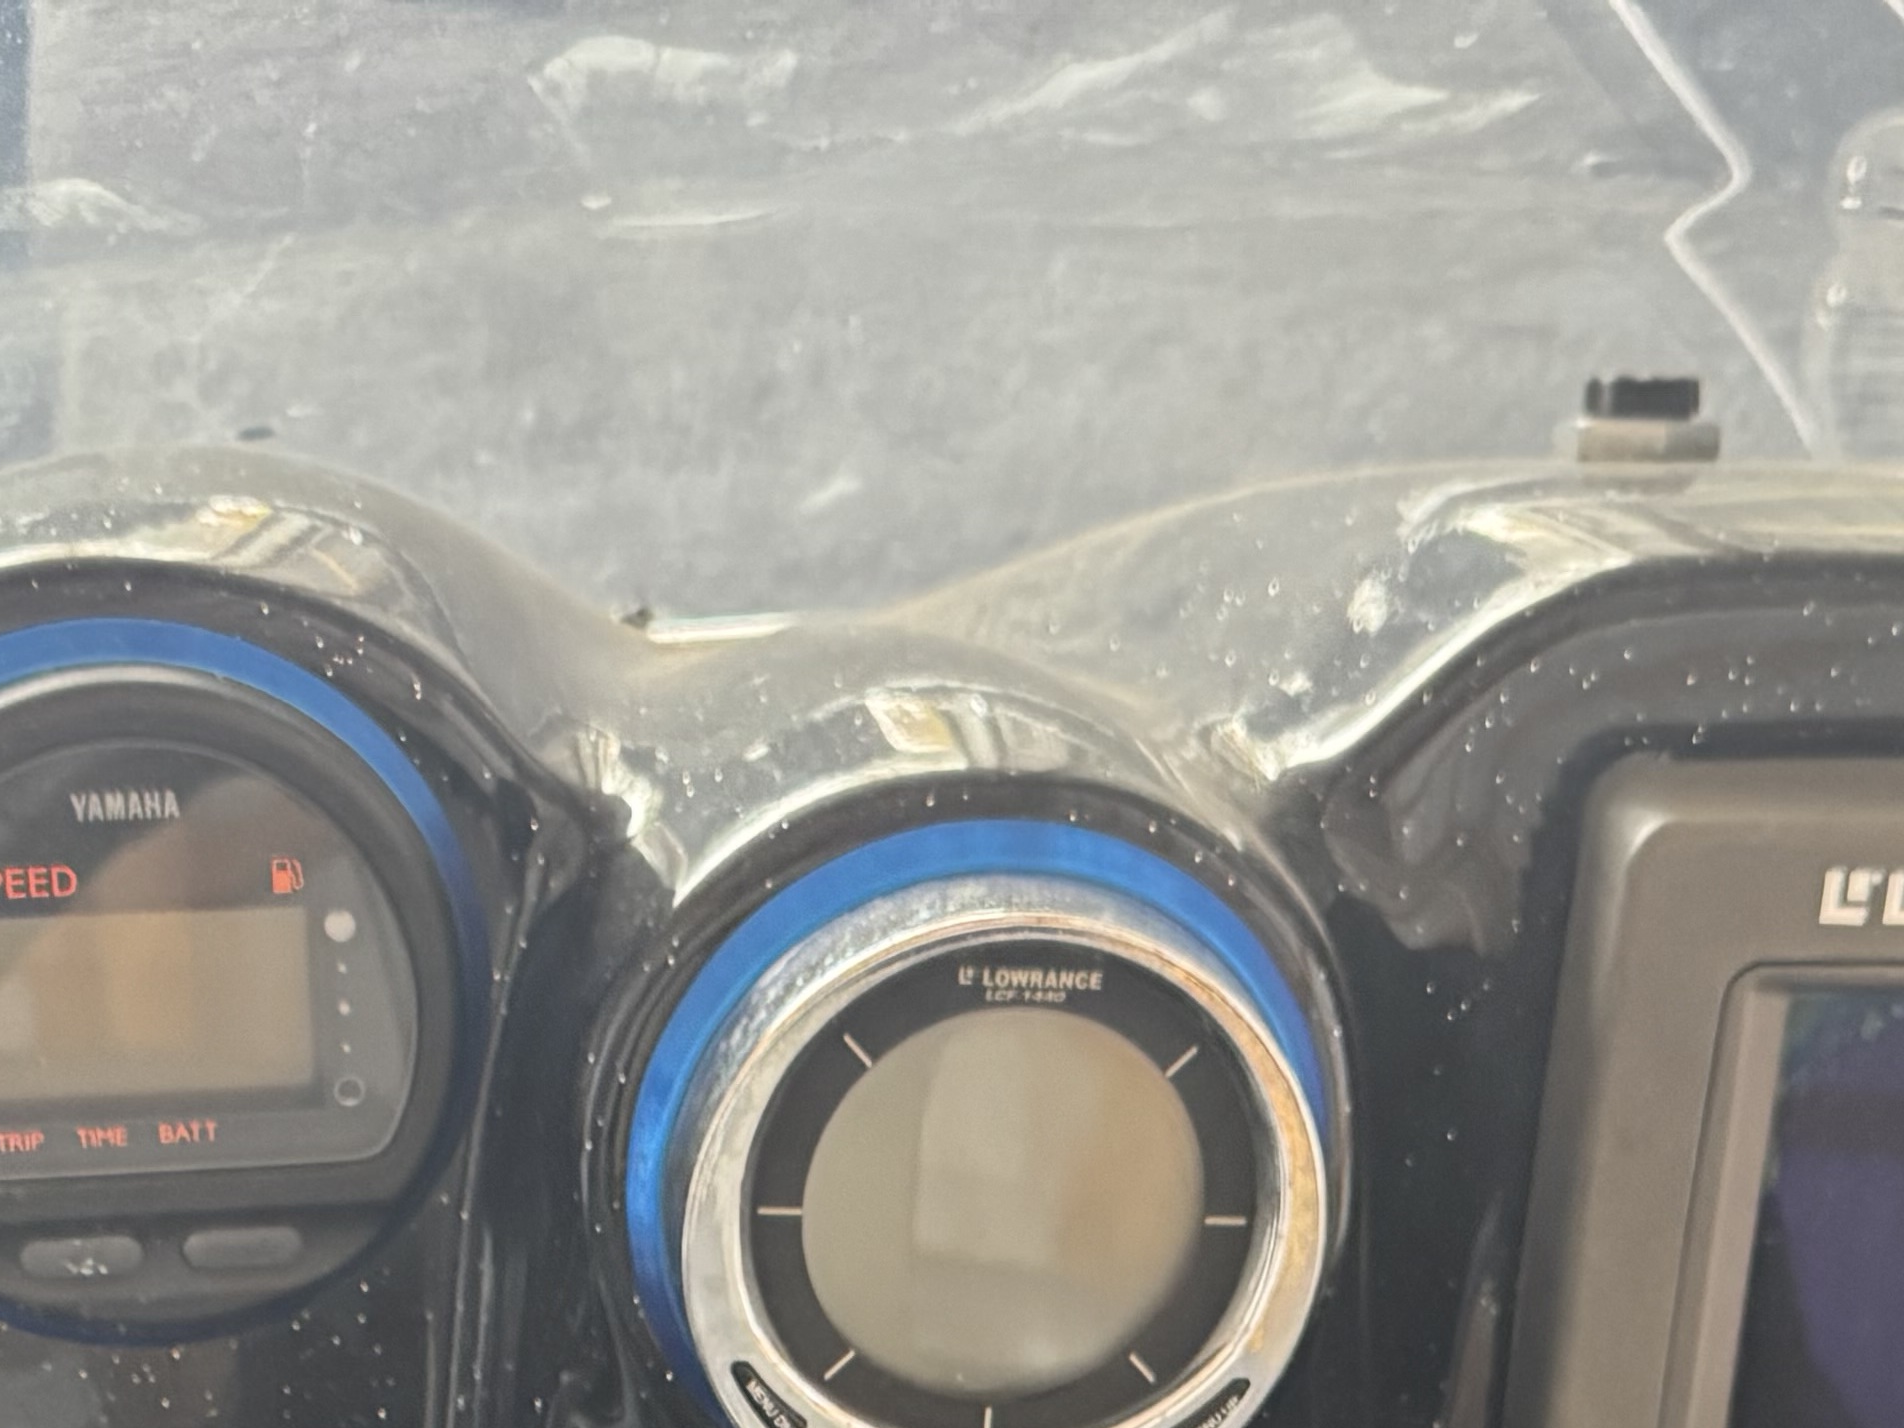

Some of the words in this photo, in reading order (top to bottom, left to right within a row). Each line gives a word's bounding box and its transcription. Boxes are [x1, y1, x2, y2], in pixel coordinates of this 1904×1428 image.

[69, 789, 180, 823] YAMAHA
[982, 965, 1103, 991] LOWRANCE
[76, 1125, 128, 1149] TIME
[158, 1118, 217, 1145] BATT
